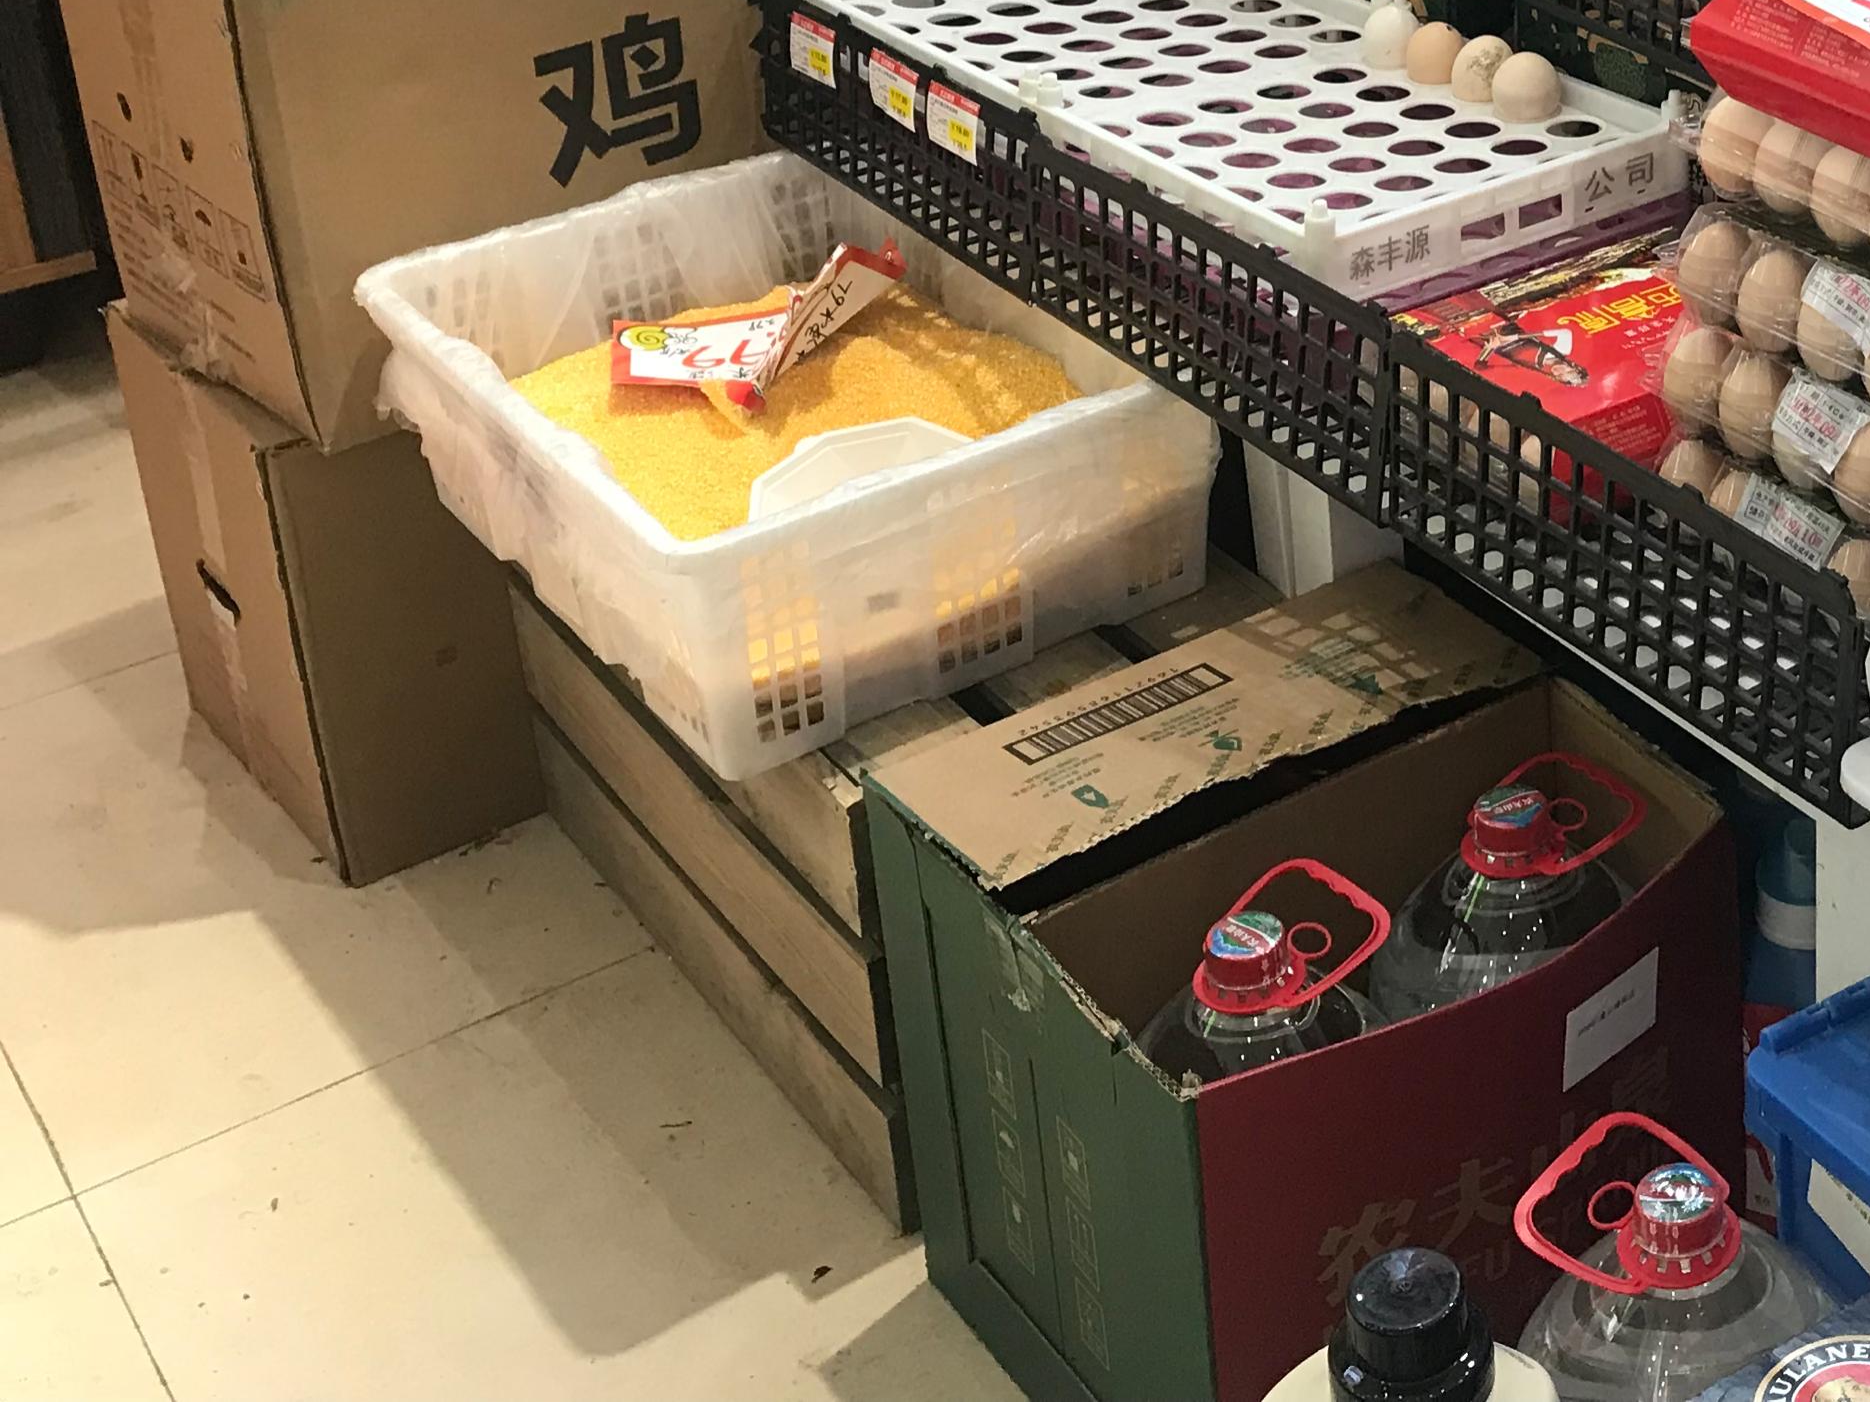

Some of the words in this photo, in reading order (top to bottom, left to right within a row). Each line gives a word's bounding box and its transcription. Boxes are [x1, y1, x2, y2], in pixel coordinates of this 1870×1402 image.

[533, 12, 702, 189] 鸡
[1584, 151, 1654, 203] 公司
[1350, 224, 1431, 281] 森丰源
